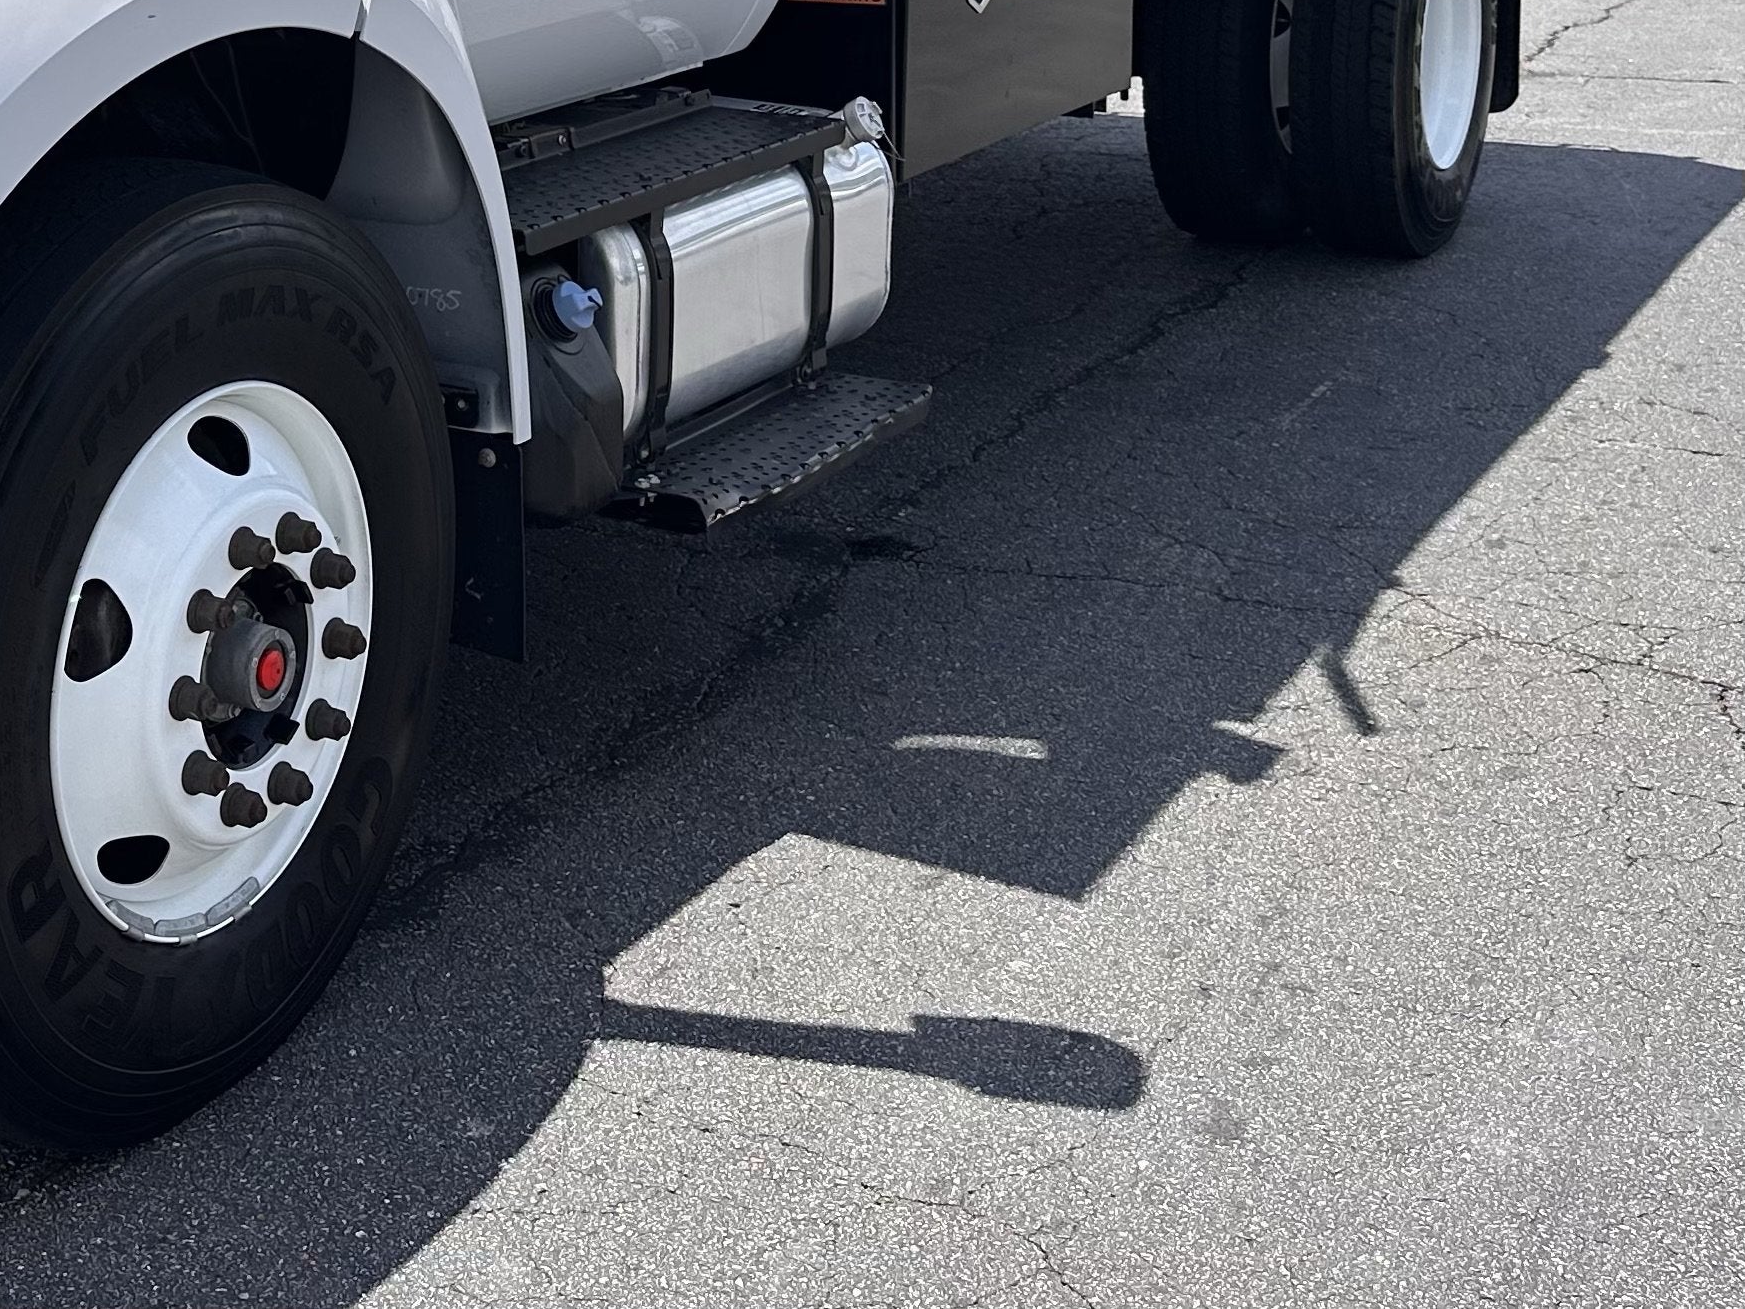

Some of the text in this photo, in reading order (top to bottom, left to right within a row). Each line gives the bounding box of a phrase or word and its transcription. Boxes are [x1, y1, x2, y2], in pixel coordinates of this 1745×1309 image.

[79, 284, 398, 467] FUEL MAX RSA
